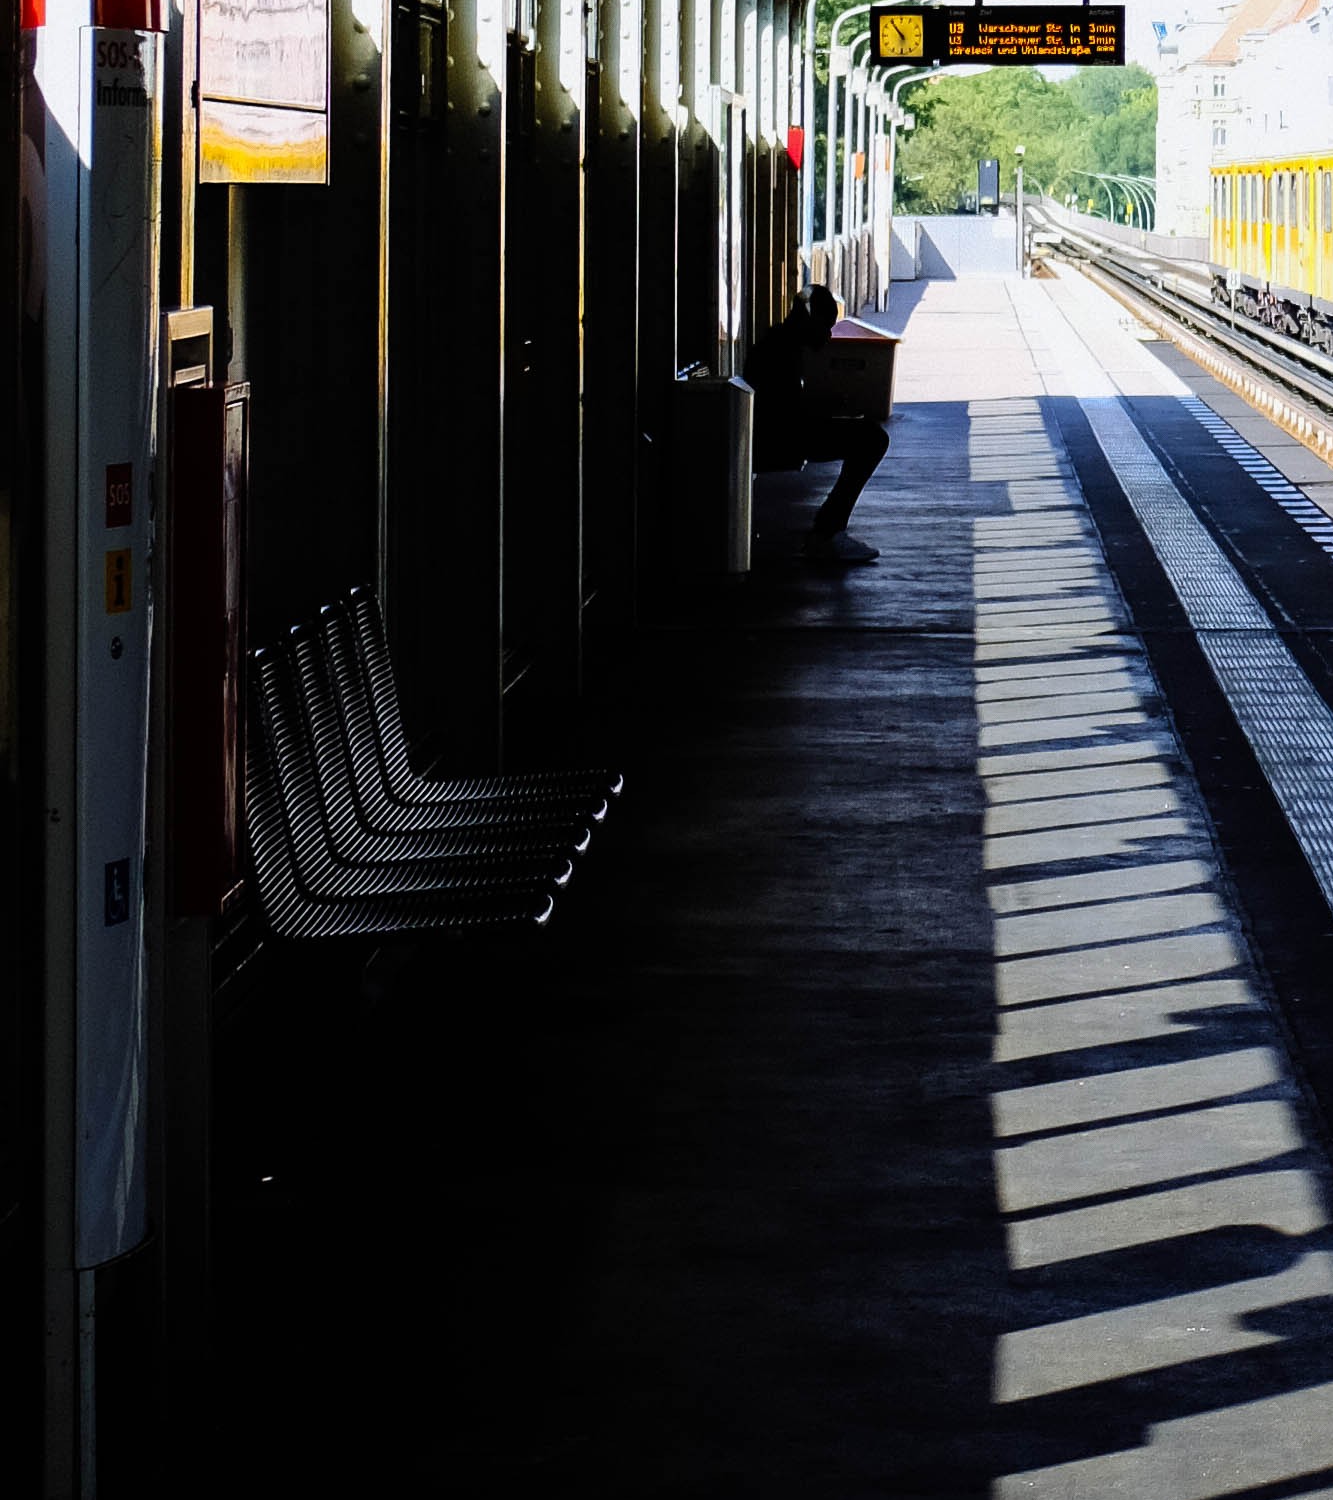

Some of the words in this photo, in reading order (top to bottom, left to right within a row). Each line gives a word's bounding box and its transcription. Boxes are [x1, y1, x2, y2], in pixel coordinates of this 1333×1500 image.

[949, 23, 964, 34] U3
[978, 23, 1041, 33] Warschauer
[1070, 23, 1081, 33] in
[978, 35, 1041, 46] Warschauer
[1070, 35, 1081, 45] in
[109, 482, 130, 506] SOS
